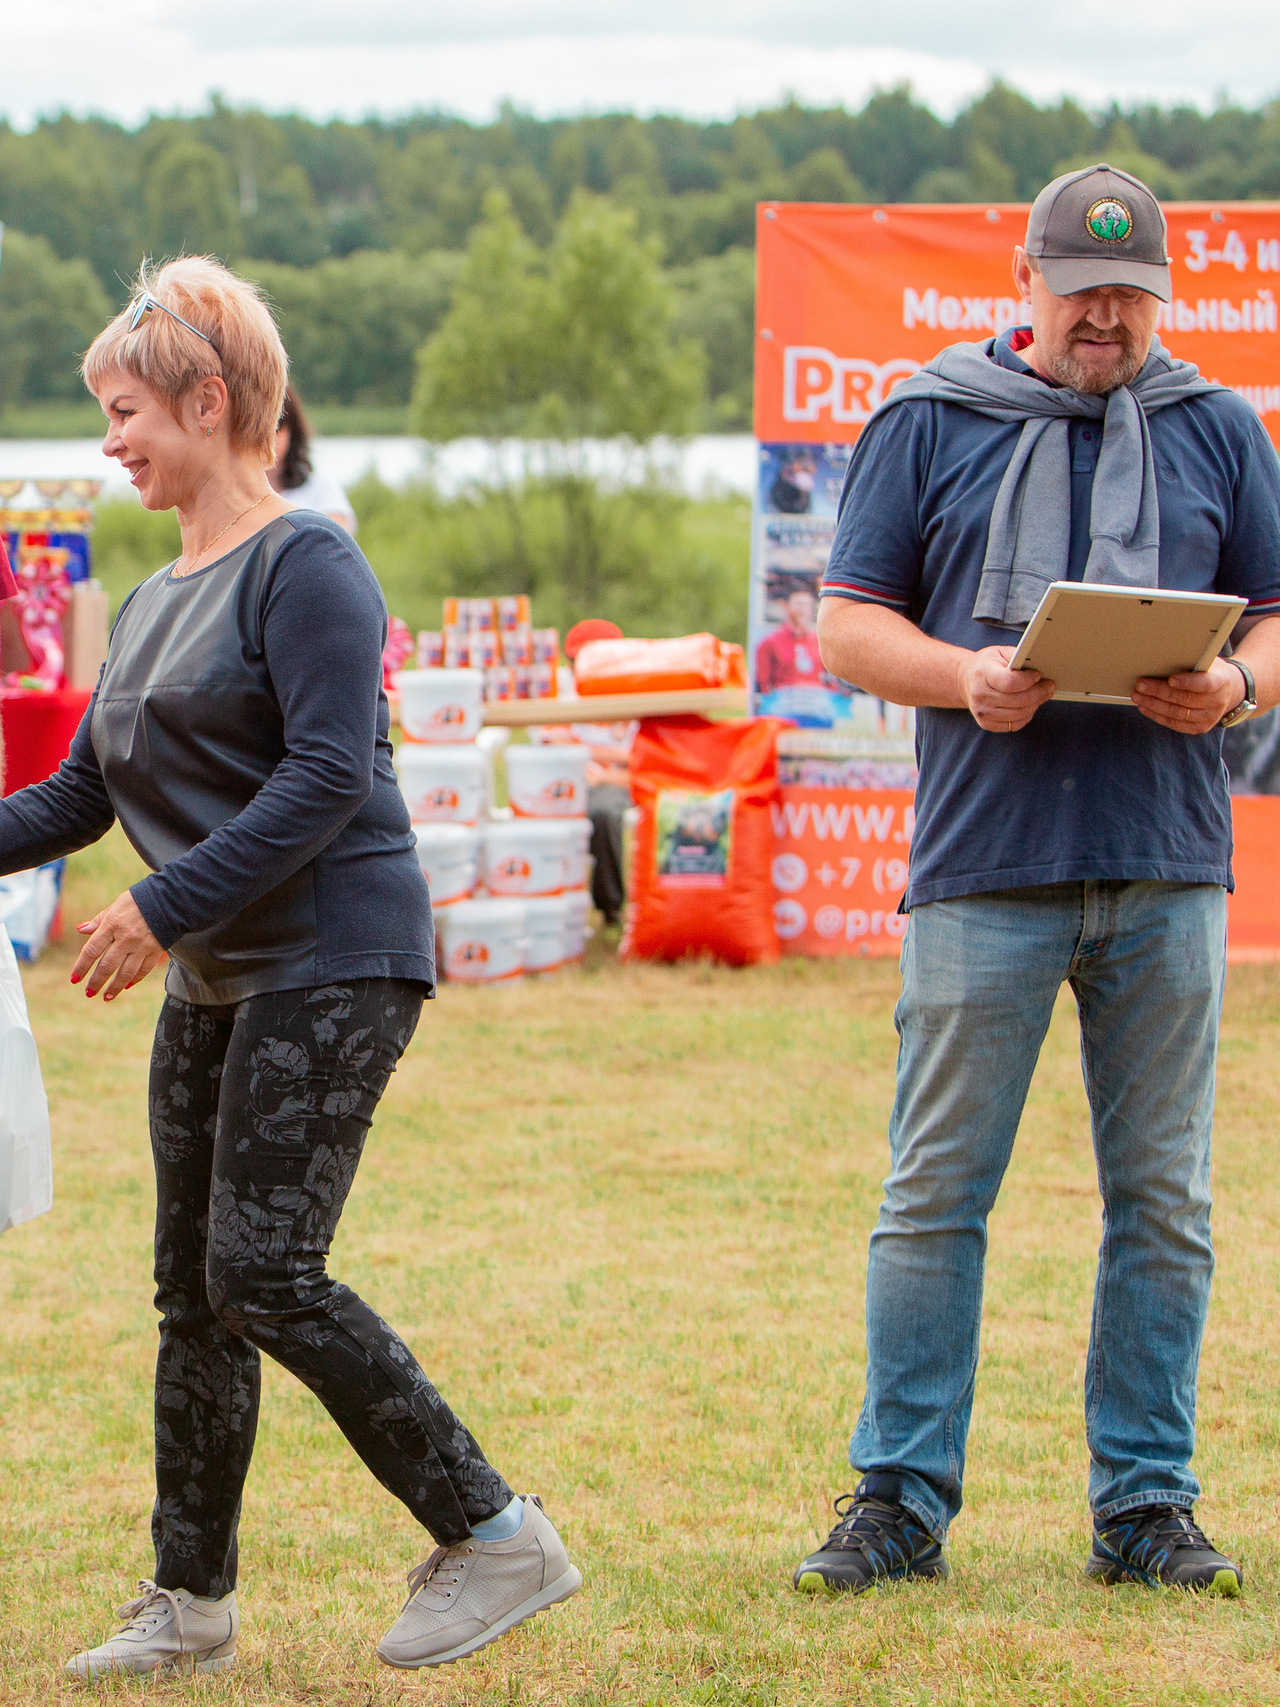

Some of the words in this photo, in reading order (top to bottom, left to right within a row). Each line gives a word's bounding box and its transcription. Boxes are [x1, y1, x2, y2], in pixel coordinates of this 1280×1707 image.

[1184, 229, 1249, 273] 3-4
[815, 857, 862, 890] +7
[814, 904, 909, 942] @pro
